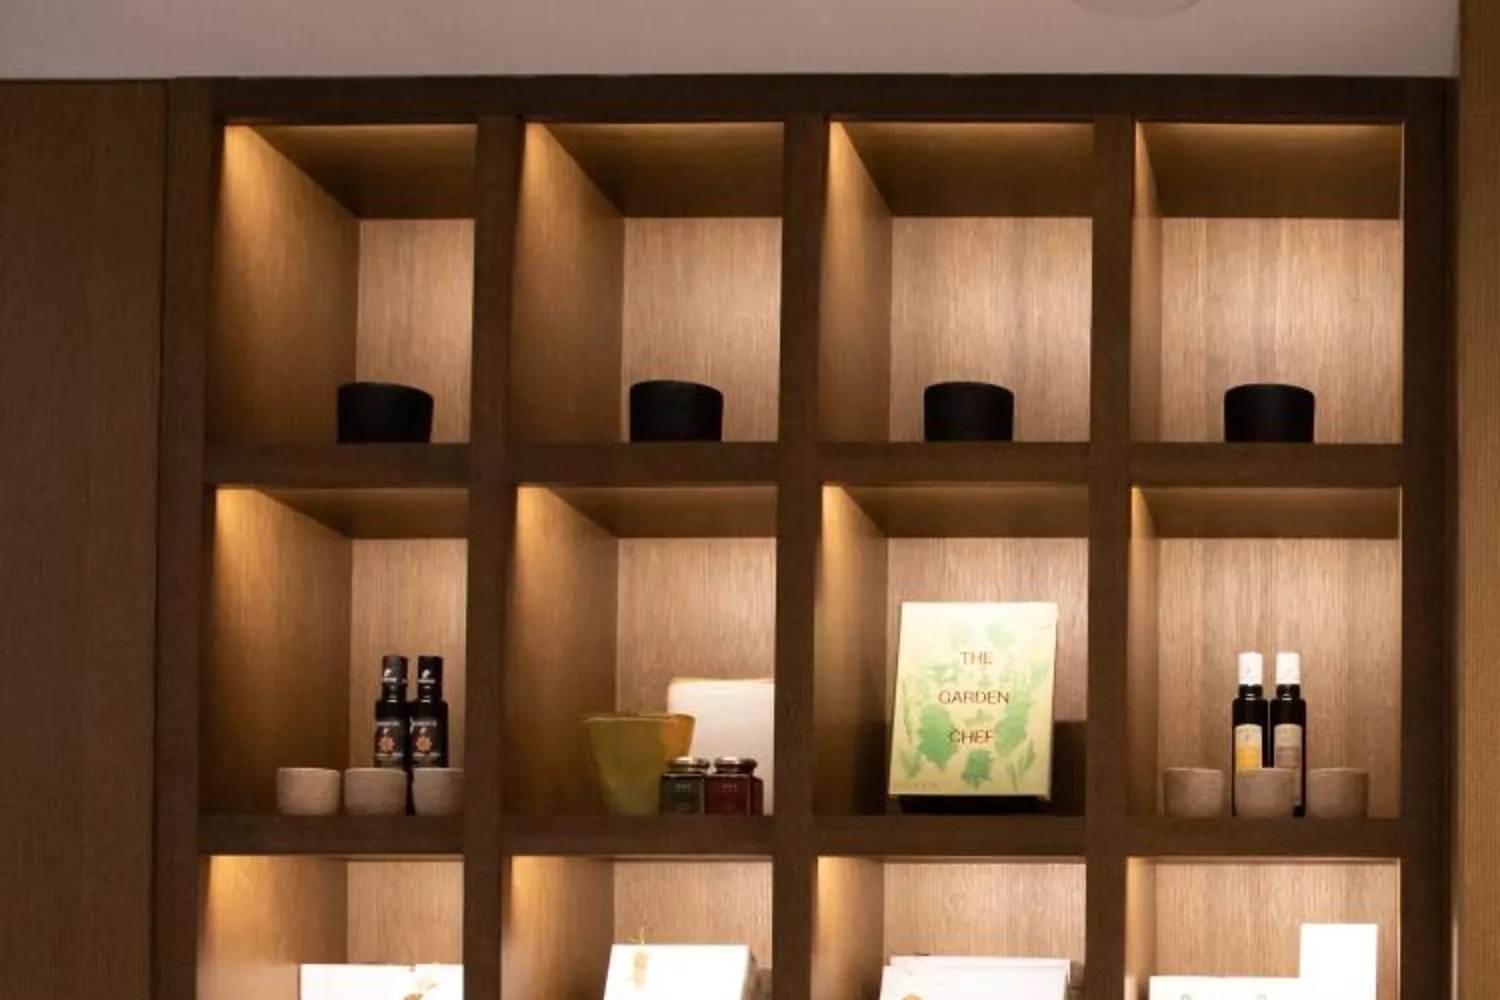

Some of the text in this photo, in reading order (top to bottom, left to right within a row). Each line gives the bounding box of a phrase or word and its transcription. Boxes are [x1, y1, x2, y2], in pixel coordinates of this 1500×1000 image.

[960, 651, 993, 664] THE
[938, 690, 1010, 704] GARDEN
[950, 729, 993, 743] CHEF
